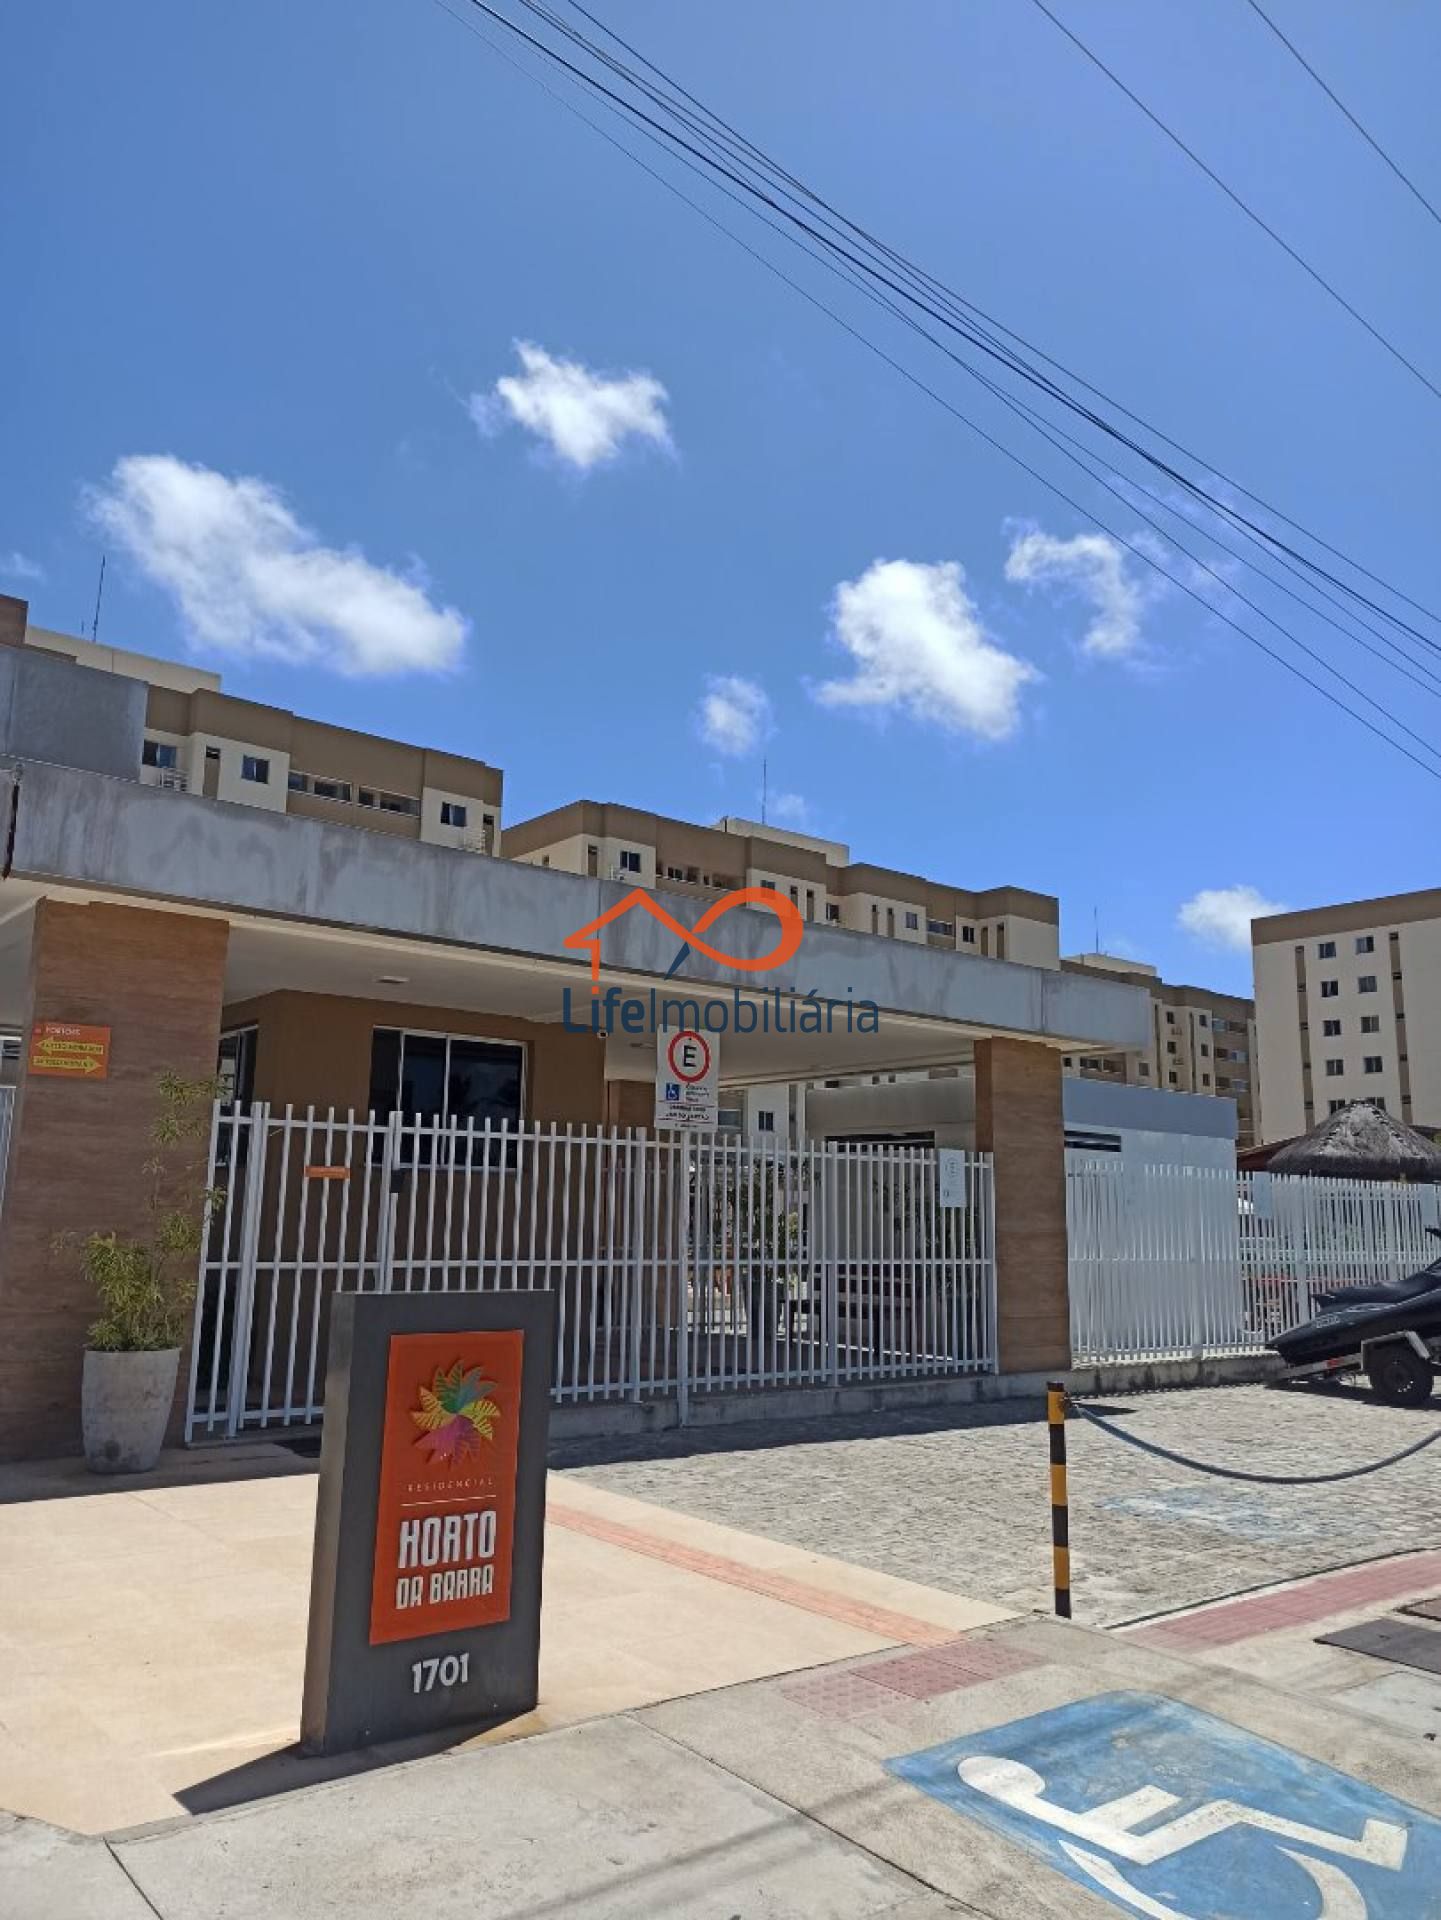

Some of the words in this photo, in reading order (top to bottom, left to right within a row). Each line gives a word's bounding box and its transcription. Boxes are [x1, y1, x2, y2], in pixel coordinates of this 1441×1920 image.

[683, 1045, 697, 1068] E
[407, 1478, 494, 1493] RESIDENCIAL
[398, 1510, 497, 1569] HORTO
[396, 1577, 424, 1610] DA
[429, 1564, 494, 1605] BARRA
[412, 1652, 470, 1694] 1701
